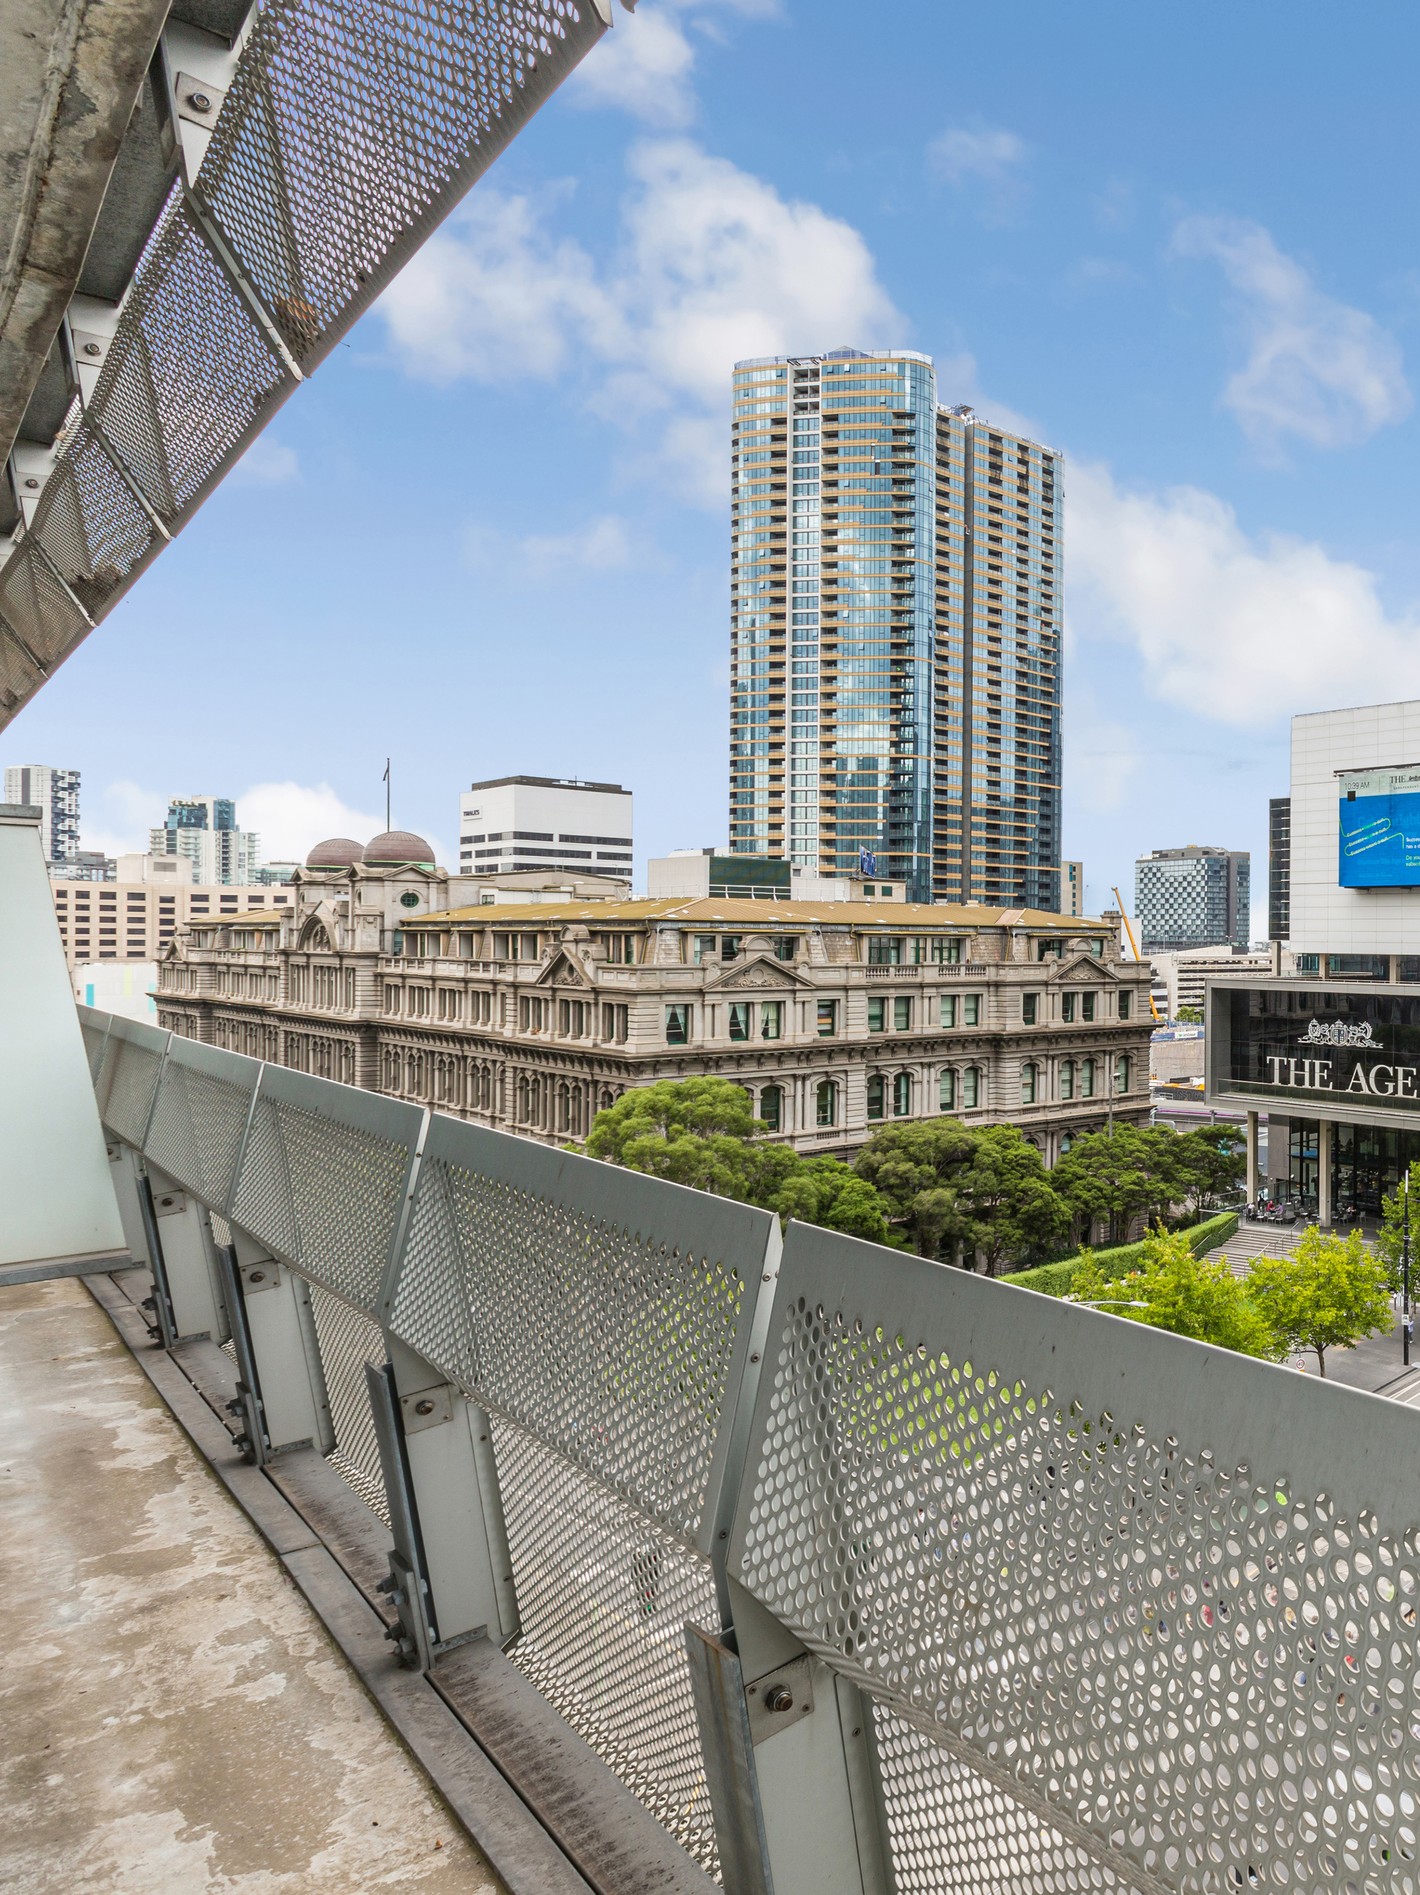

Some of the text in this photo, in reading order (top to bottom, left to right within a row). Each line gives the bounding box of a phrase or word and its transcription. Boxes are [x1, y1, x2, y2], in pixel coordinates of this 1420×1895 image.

[1390, 774, 1406, 784] THE
[1266, 1056, 1418, 1098] THE AGE
